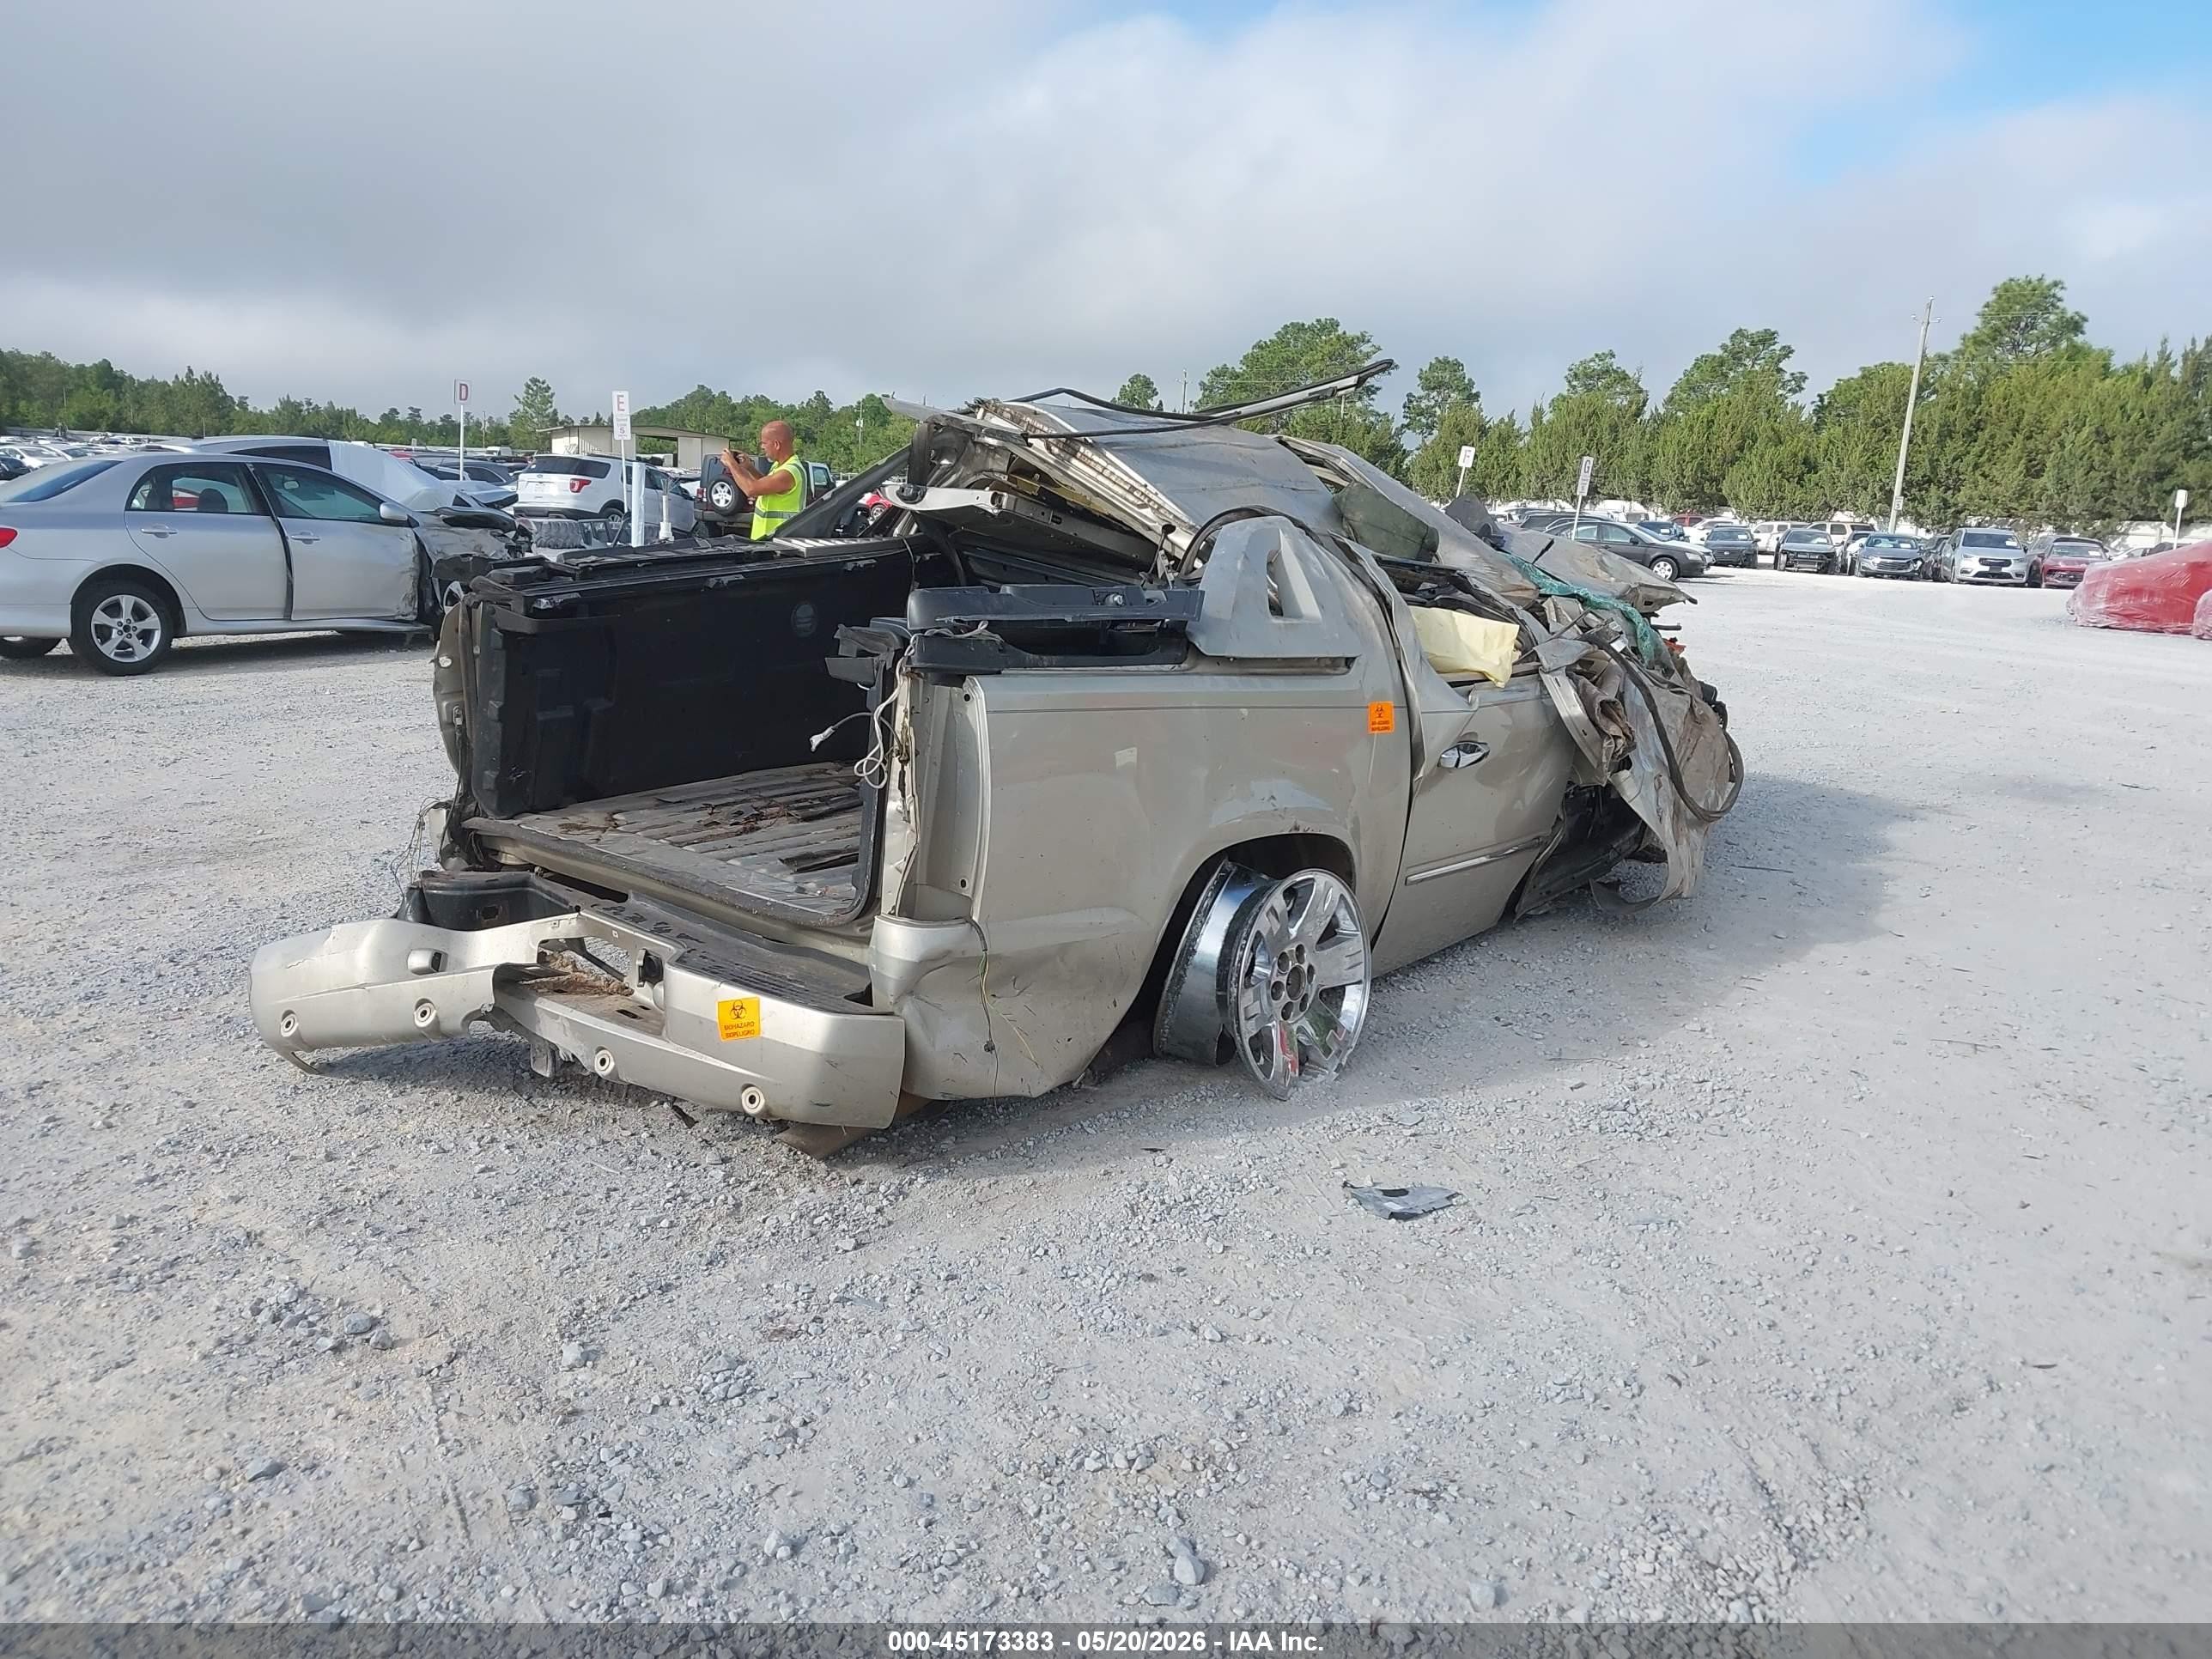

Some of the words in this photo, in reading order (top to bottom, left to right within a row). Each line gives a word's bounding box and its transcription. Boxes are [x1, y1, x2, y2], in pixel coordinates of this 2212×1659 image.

[459, 383, 469, 401] D
[617, 395, 625, 411] E
[1462, 450, 1471, 463] F
[1583, 459, 1591, 474] G
